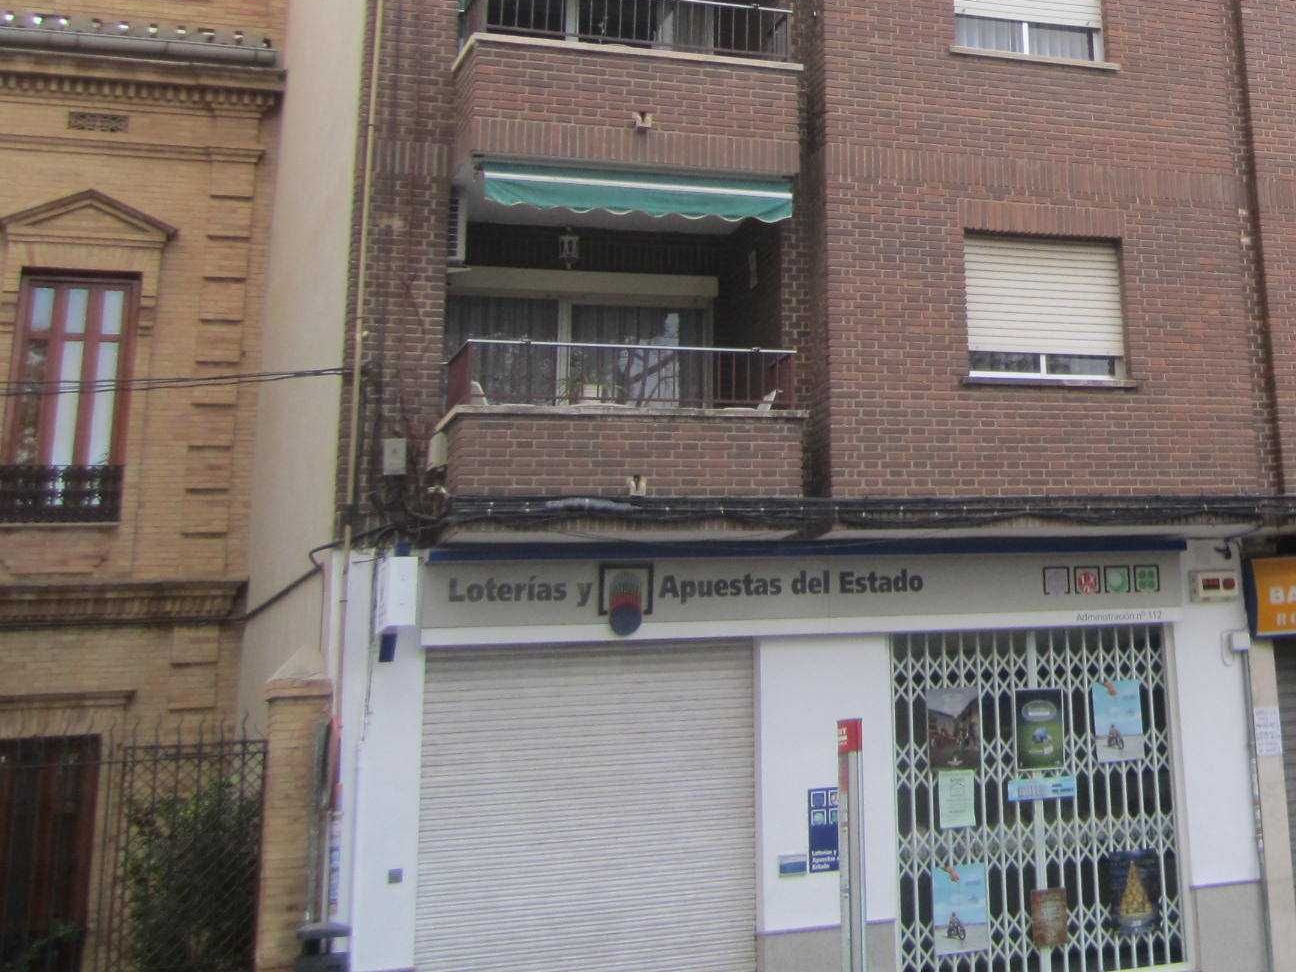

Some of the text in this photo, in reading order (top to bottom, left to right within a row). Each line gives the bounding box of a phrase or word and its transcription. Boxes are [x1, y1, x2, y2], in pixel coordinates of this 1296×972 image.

[448, 568, 924, 607] Loterías y Apuestas del Estado
